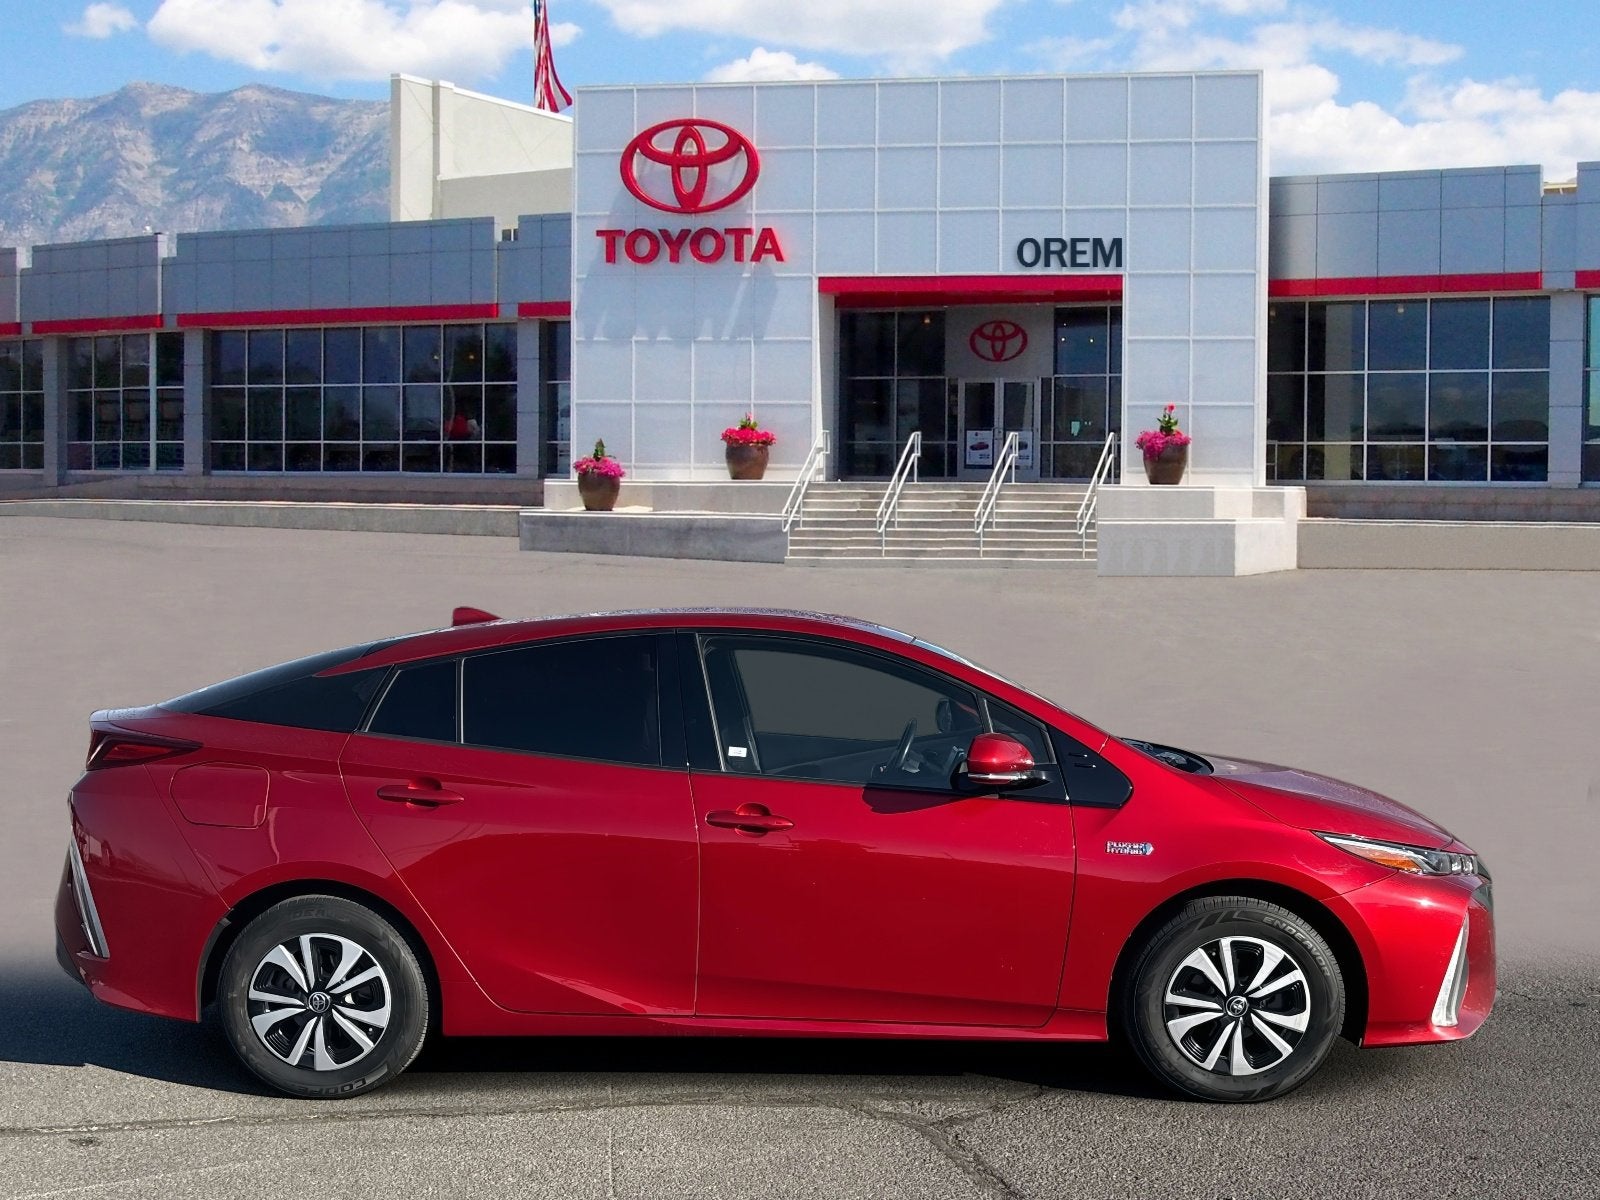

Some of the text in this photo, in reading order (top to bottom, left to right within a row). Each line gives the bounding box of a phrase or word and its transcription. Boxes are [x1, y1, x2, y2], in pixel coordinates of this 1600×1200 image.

[596, 227, 785, 264] TOYOTA
[1017, 237, 1122, 268] OREM
[1262, 916, 1330, 977] ENDEAVOR
